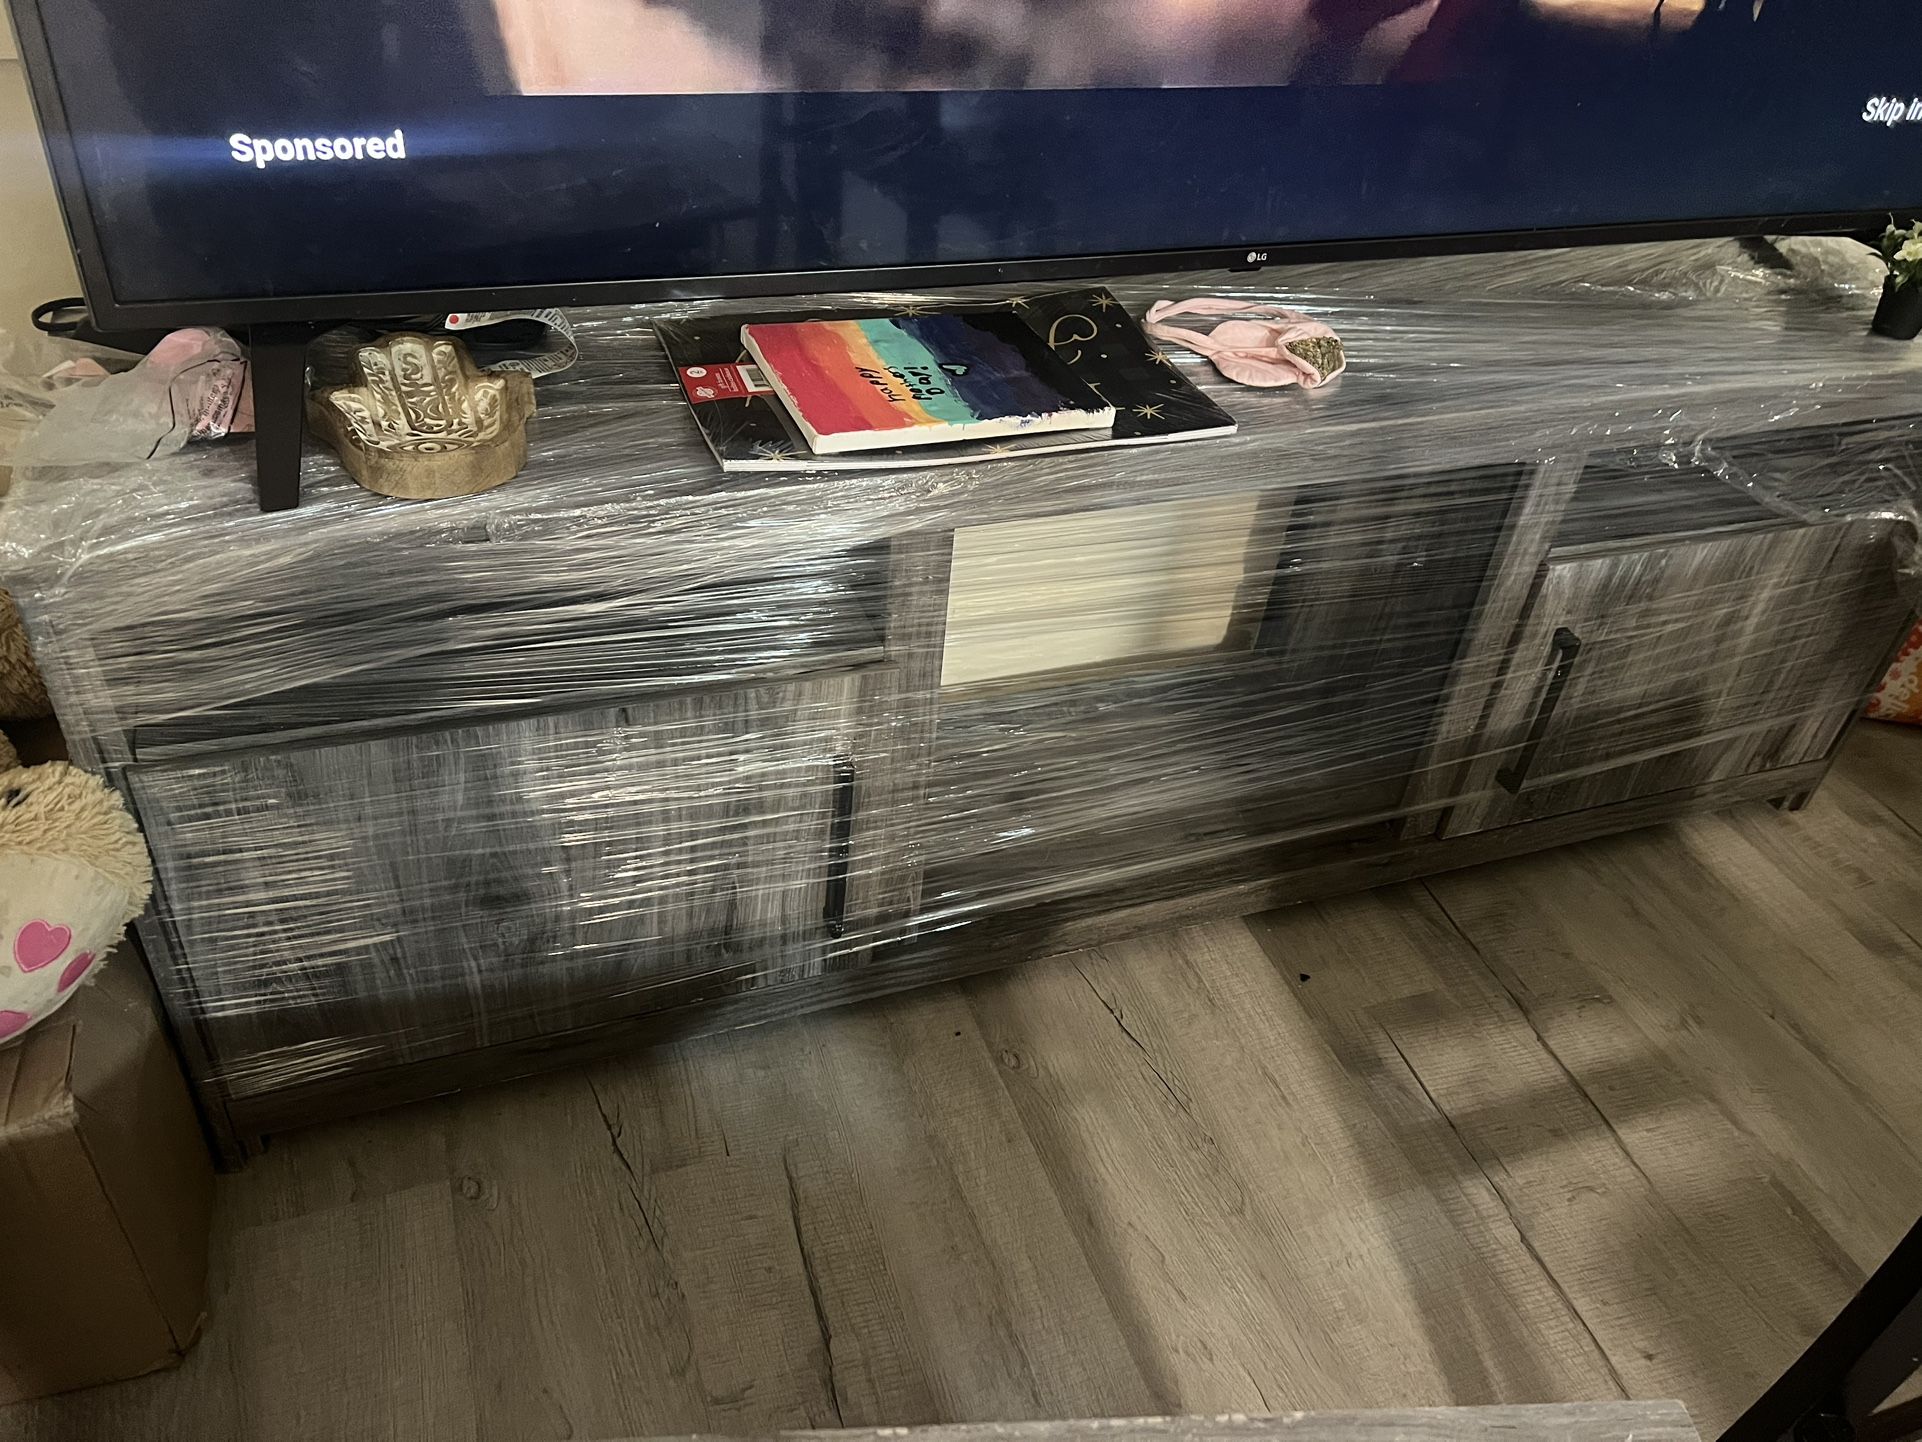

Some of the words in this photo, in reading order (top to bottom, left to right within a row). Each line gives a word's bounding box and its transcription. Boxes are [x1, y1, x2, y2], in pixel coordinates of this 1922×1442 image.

[1862, 96, 1905, 127] Skip
[229, 129, 406, 169] Sponsored
[855, 366, 906, 402] happy
